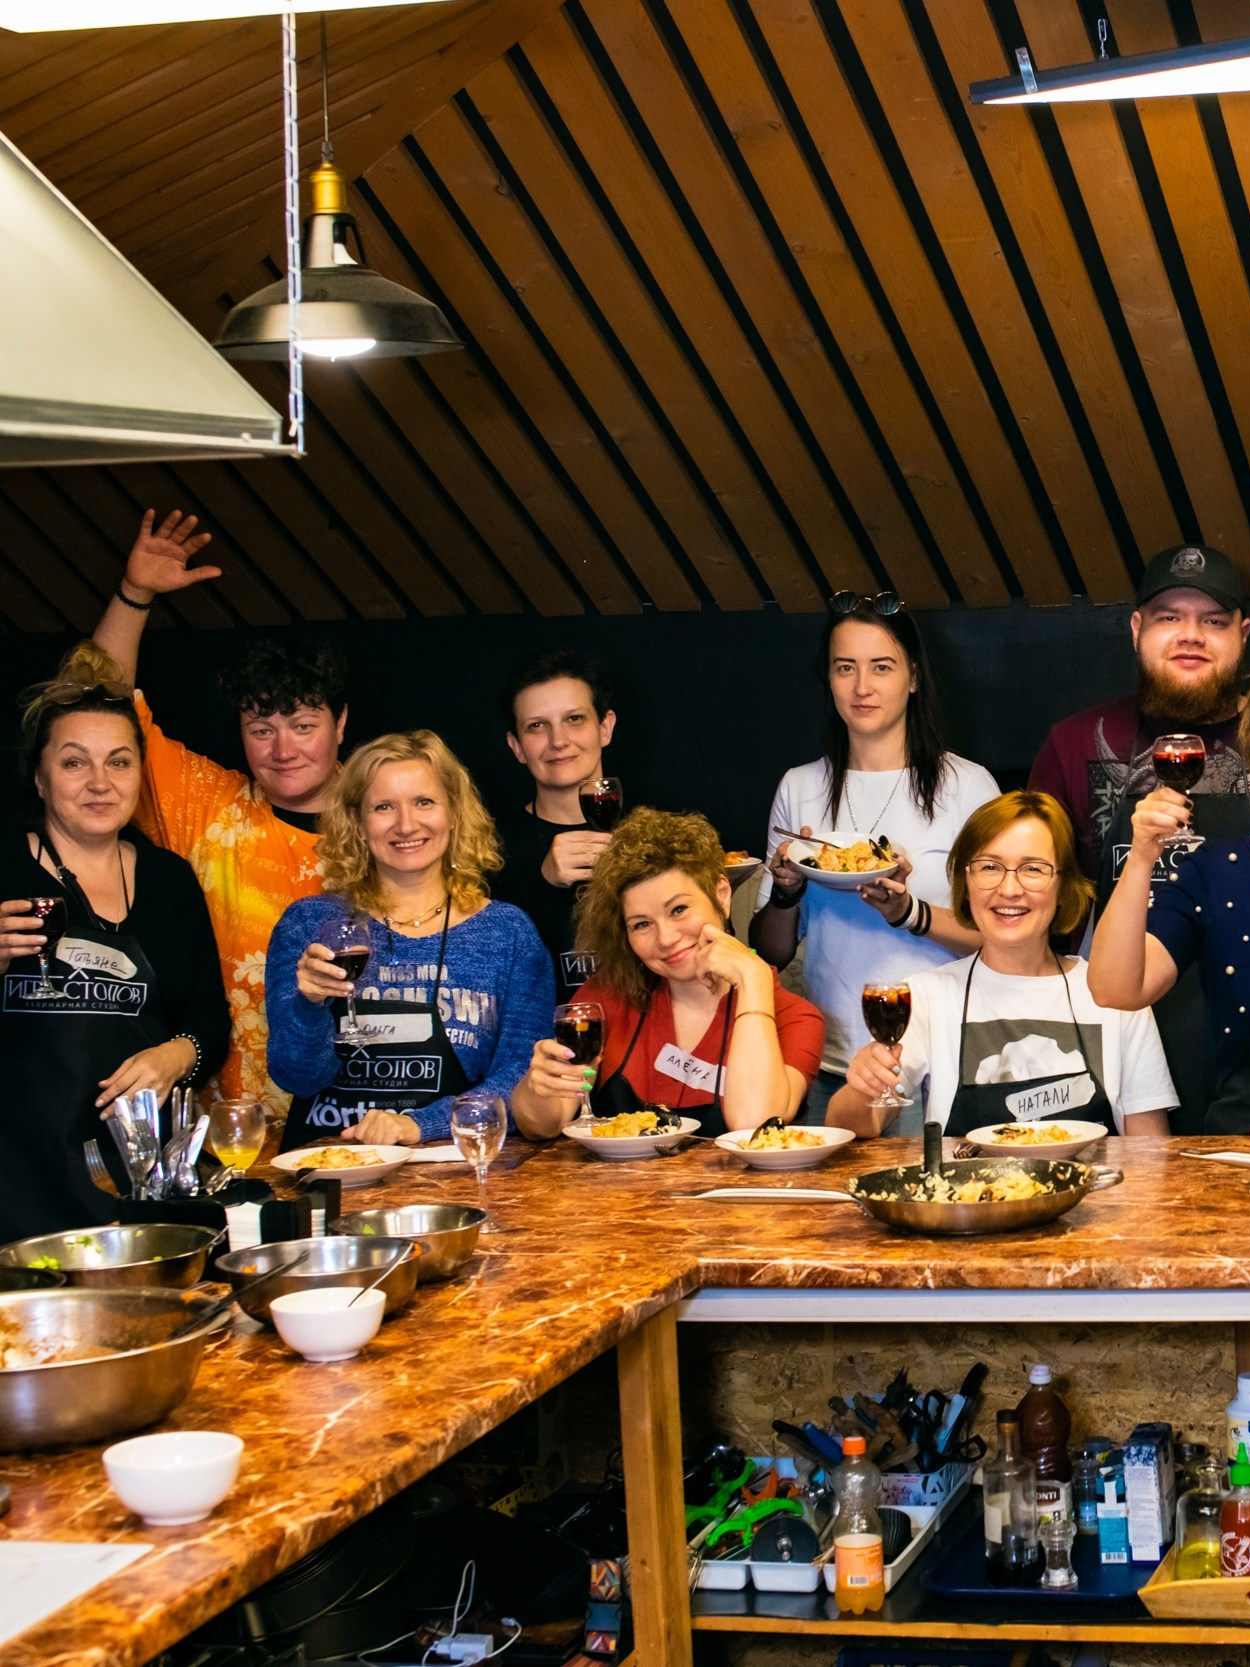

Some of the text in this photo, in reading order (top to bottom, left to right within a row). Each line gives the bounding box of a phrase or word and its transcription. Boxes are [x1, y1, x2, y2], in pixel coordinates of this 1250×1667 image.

[64, 981, 141, 1004] СТОЛОВ
[347, 1059, 436, 1079] СТОЛОВ
[1018, 1085, 1070, 1114] НАТАЛИ
[1036, 1492, 1057, 1501] ONTI
